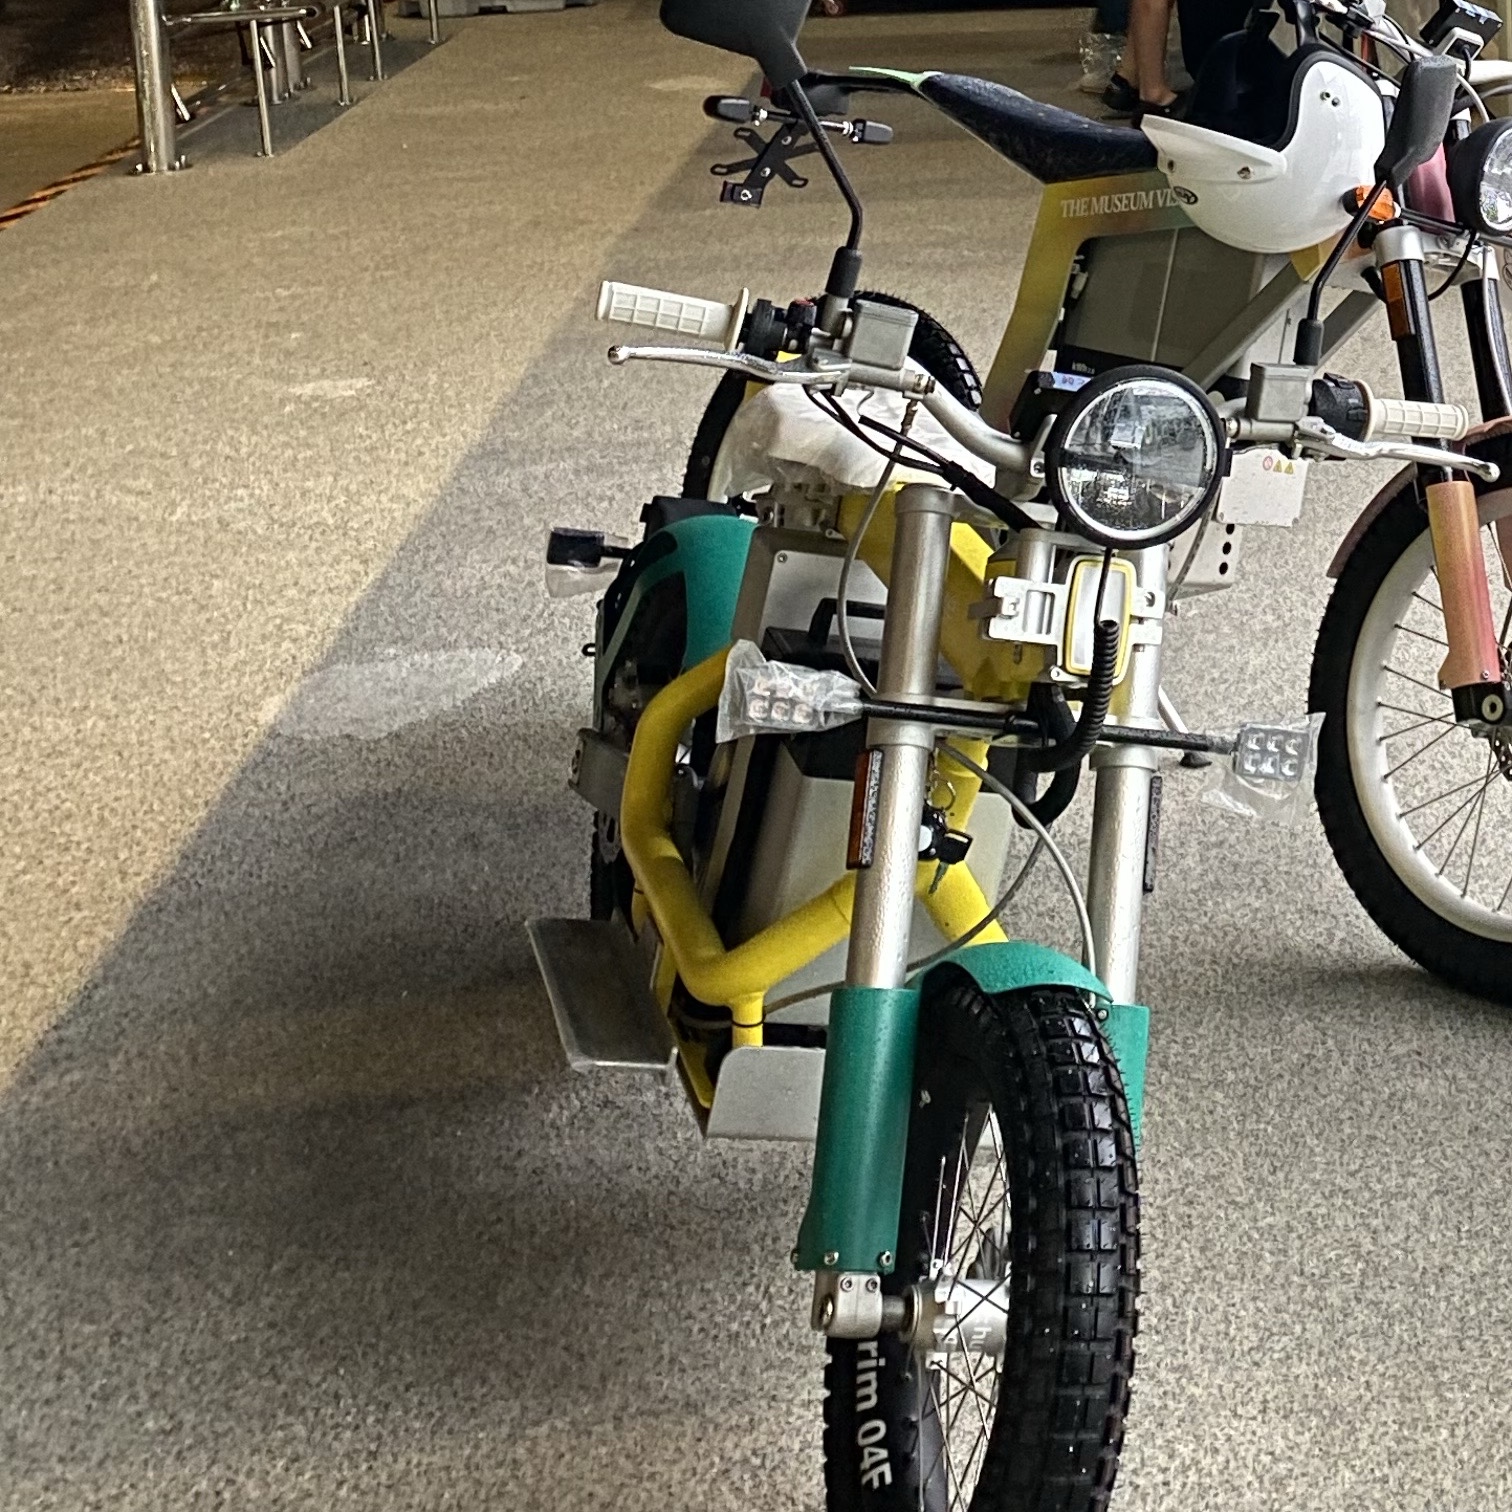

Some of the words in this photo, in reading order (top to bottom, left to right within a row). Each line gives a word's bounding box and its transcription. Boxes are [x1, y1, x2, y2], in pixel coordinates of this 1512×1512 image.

[1060, 197, 1090, 218] THE
[1090, 191, 1154, 215] MUSEUM
[856, 1340, 886, 1413] rim
[857, 1419, 893, 1489] 04F
